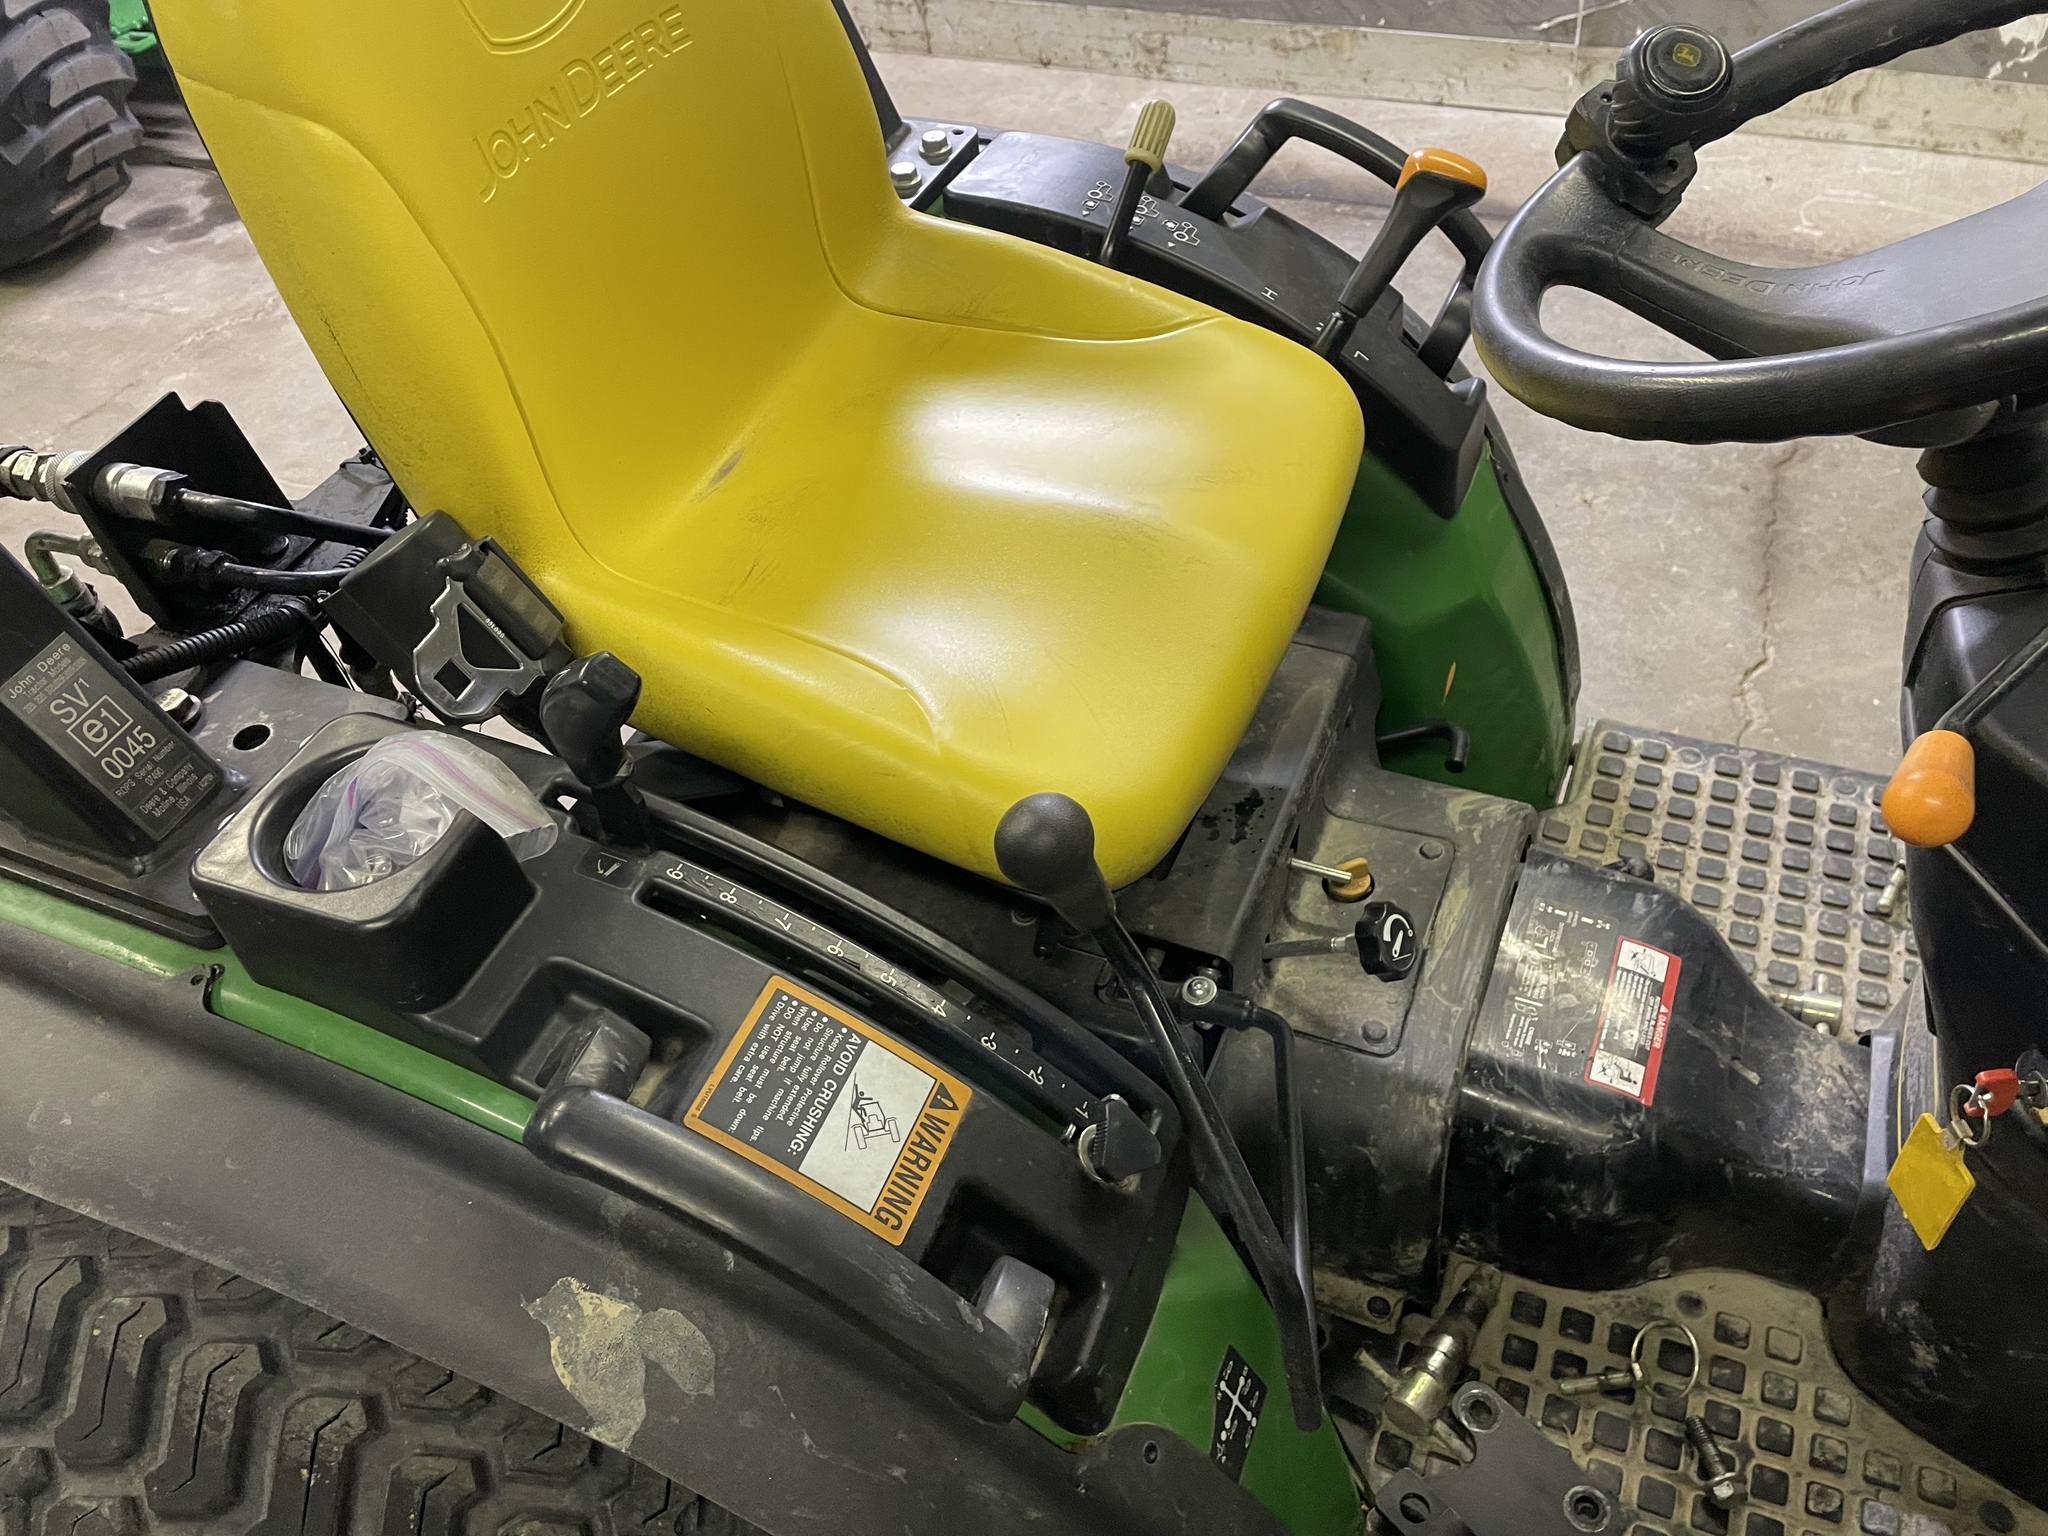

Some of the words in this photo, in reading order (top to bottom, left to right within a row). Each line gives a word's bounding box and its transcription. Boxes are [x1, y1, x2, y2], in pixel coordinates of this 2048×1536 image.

[472, 86, 571, 203] JOHN
[558, 3, 694, 118] DEERE
[1783, 268, 1886, 295] JOHN
[1260, 286, 1278, 301] H
[9, 675, 35, 699] John
[36, 643, 71, 673] Deere
[101, 725, 156, 779] 0045
[115, 778, 136, 798] ROPS
[134, 760, 154, 780] Serial
[151, 740, 175, 762] Number
[139, 794, 161, 814] Deere
[164, 760, 194, 789] Company
[175, 795, 192, 810] USA
[768, 1001, 785, 1021] Drive
[783, 1006, 795, 1020] DO
[791, 1006, 809, 1026] When
[756, 1023, 771, 1040] with
[770, 1023, 785, 1042] NOT
[800, 1017, 814, 1031] Use
[813, 1021, 824, 1033] Do
[1652, 1014, 1667, 1049] DANGER
[743, 1042, 759, 1062] extra
[769, 1030, 793, 1064] structure
[788, 1035, 802, 1052] seat
[802, 1036, 814, 1051] not
[809, 1027, 834, 1061] Structure
[827, 1032, 844, 1052] Keep
[758, 1045, 771, 1060] use
[789, 1052, 806, 1073] jump
[832, 1032, 862, 1076] AVOID
[745, 1064, 759, 1082] seat
[776, 1055, 792, 1071] belt.
[809, 1054, 832, 1086] Rollover
[729, 1064, 745, 1083] care.
[754, 1068, 770, 1089] must
[783, 1077, 792, 1085] if
[796, 1065, 812, 1083] fully
[731, 1086, 748, 1103] belt.
[745, 1092, 757, 1104] be
[762, 1088, 784, 1121] machine
[775, 1084, 800, 1121] extended.
[786, 1087, 813, 1127] Protective
[787, 1079, 837, 1155] CRUSHING:
[728, 1108, 747, 1133] down:
[749, 1125, 764, 1142] tips.
[873, 1112, 950, 1231] WARNING
